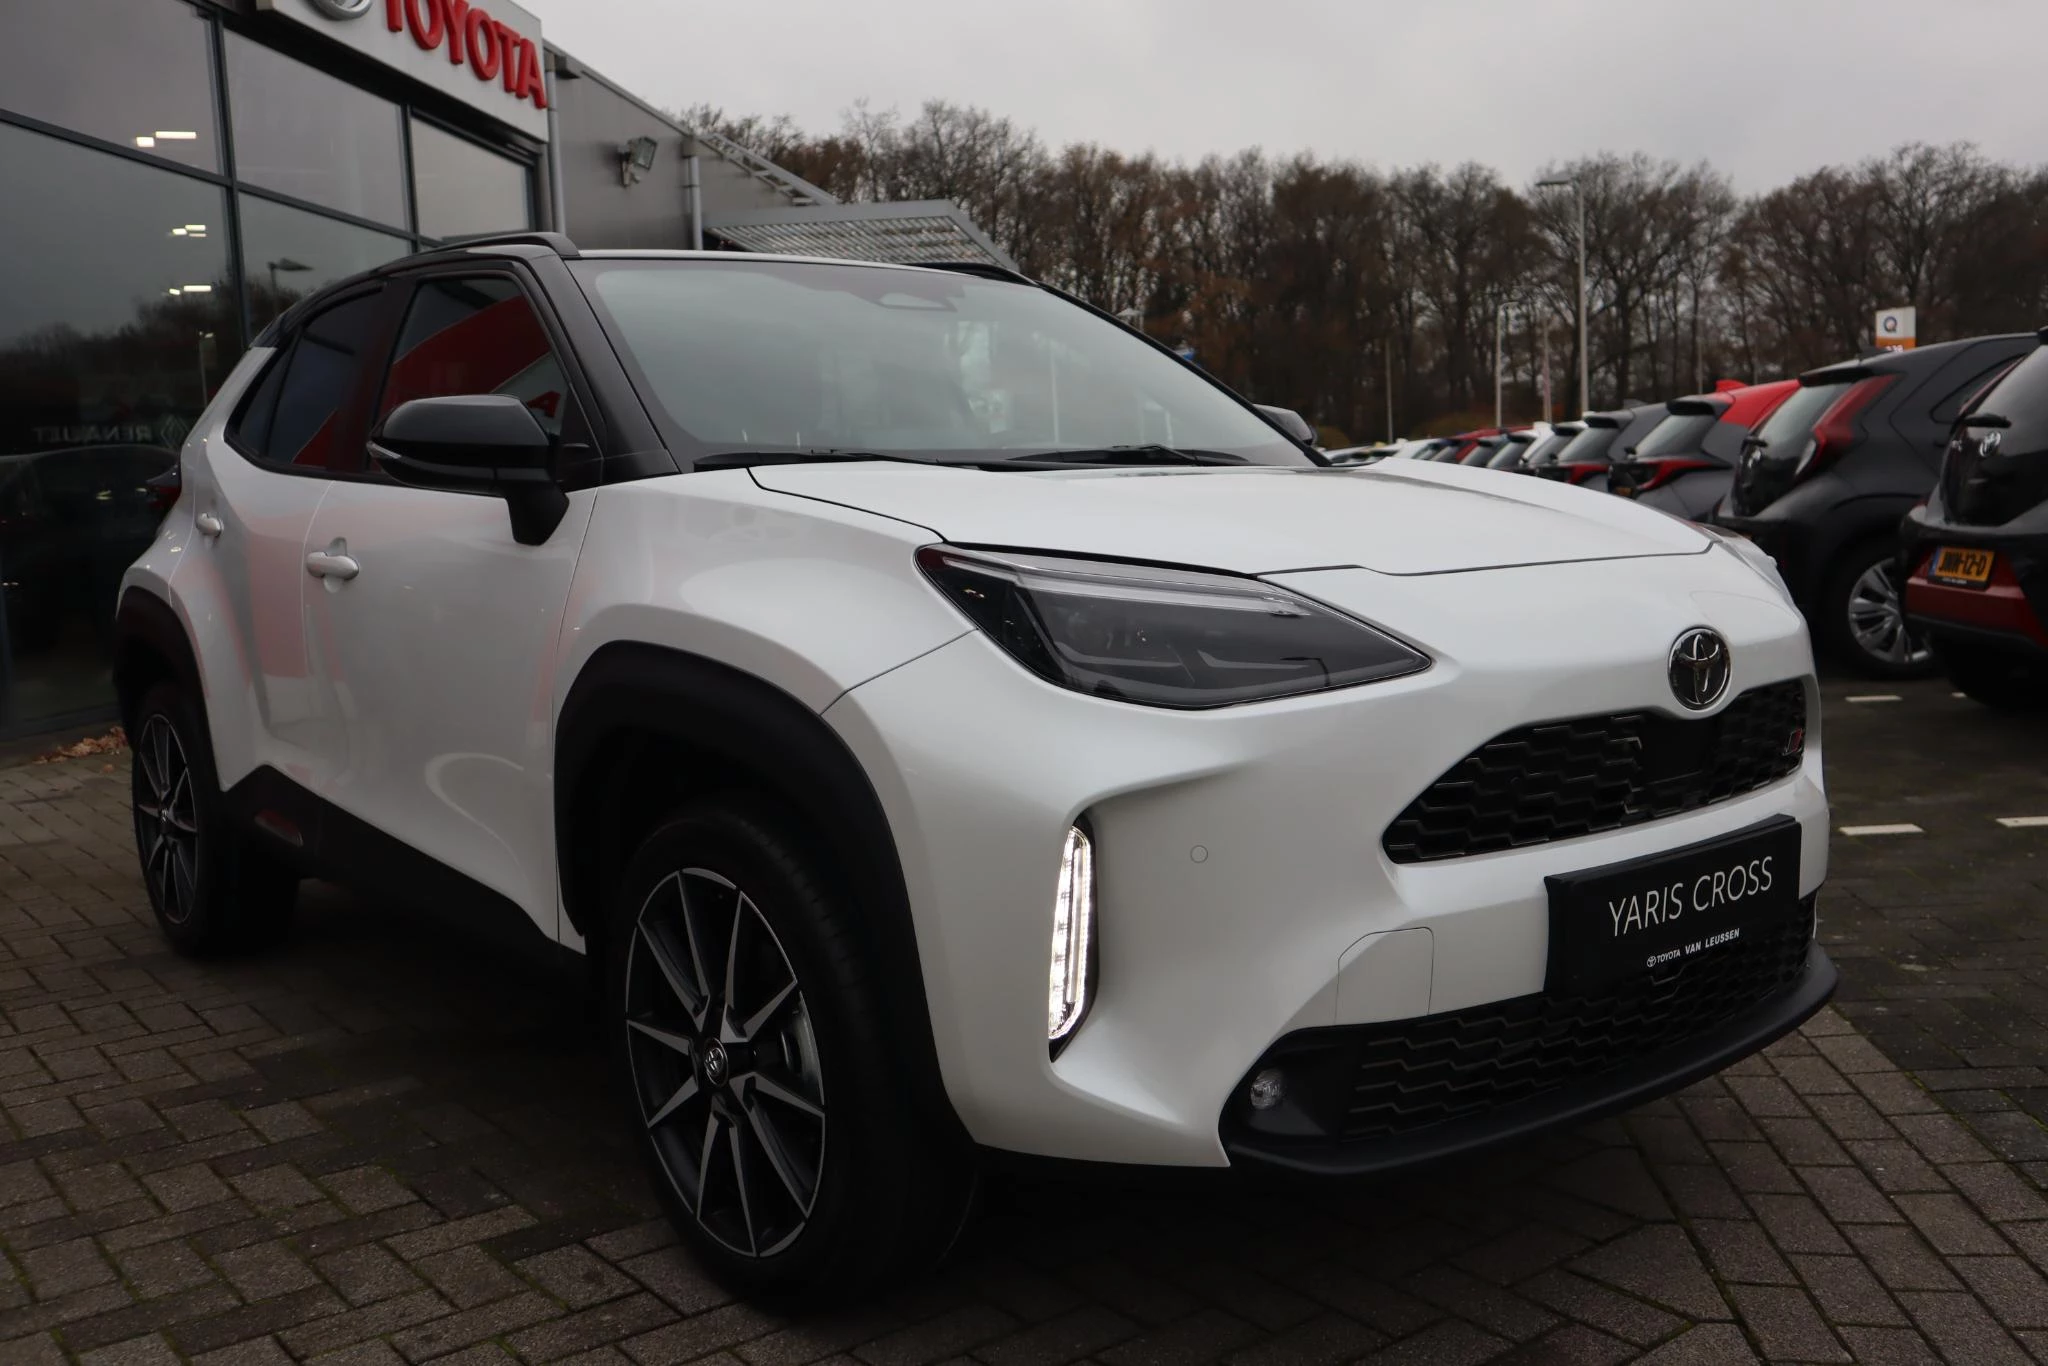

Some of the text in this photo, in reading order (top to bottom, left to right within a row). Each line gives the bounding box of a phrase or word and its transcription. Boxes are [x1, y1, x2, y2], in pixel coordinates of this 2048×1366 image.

[1608, 856, 1773, 937] YARIS CROSS
[1656, 928, 1740, 964] TOYOTA VAN LEUSSEN
